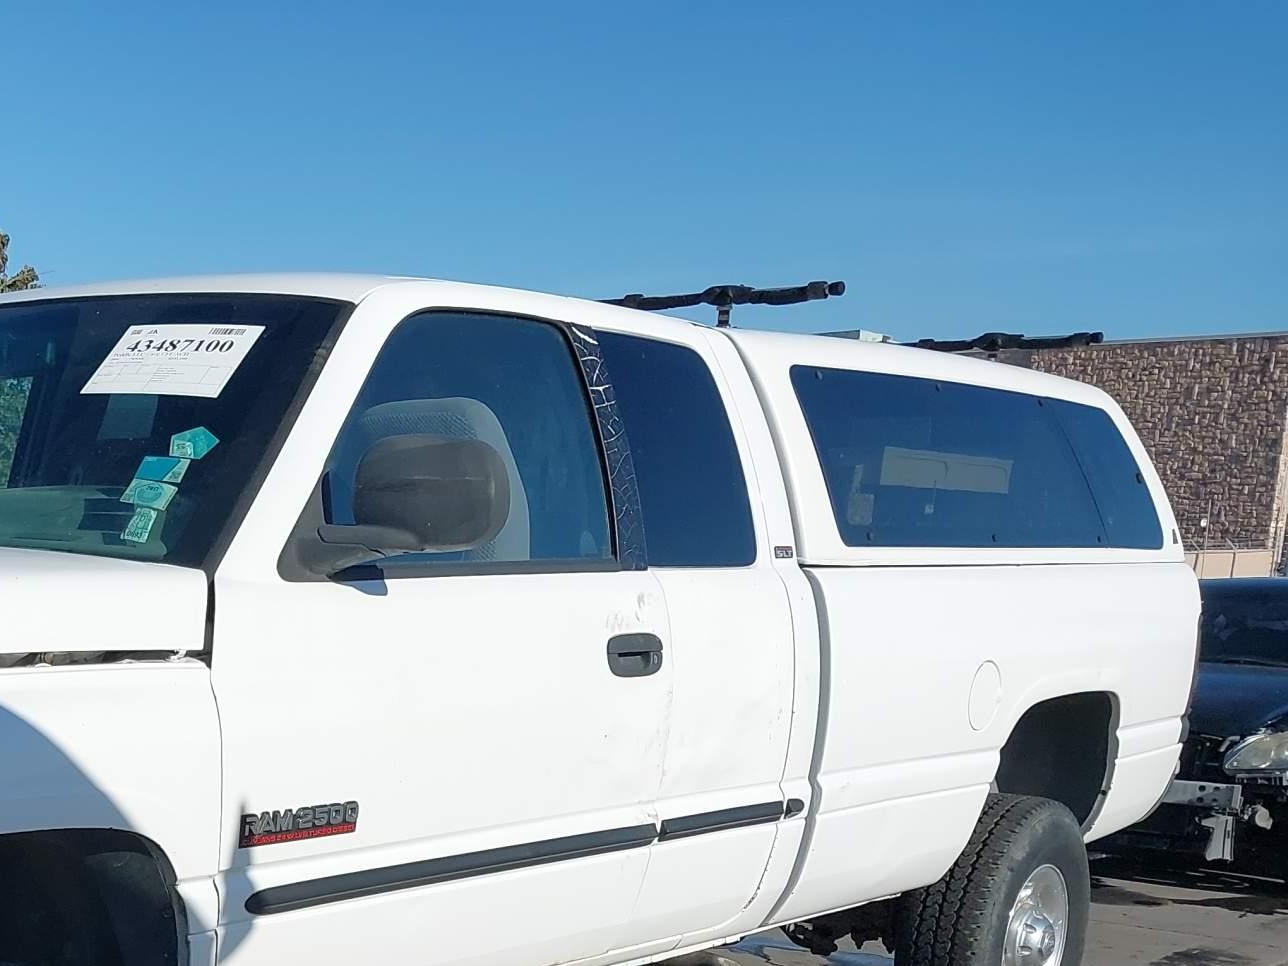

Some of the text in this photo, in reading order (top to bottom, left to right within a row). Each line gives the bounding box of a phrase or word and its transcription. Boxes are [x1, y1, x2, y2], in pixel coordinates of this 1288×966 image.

[126, 339, 234, 353] 43487100
[776, 550, 793, 558] SLT
[242, 801, 359, 839] RAM 2500
